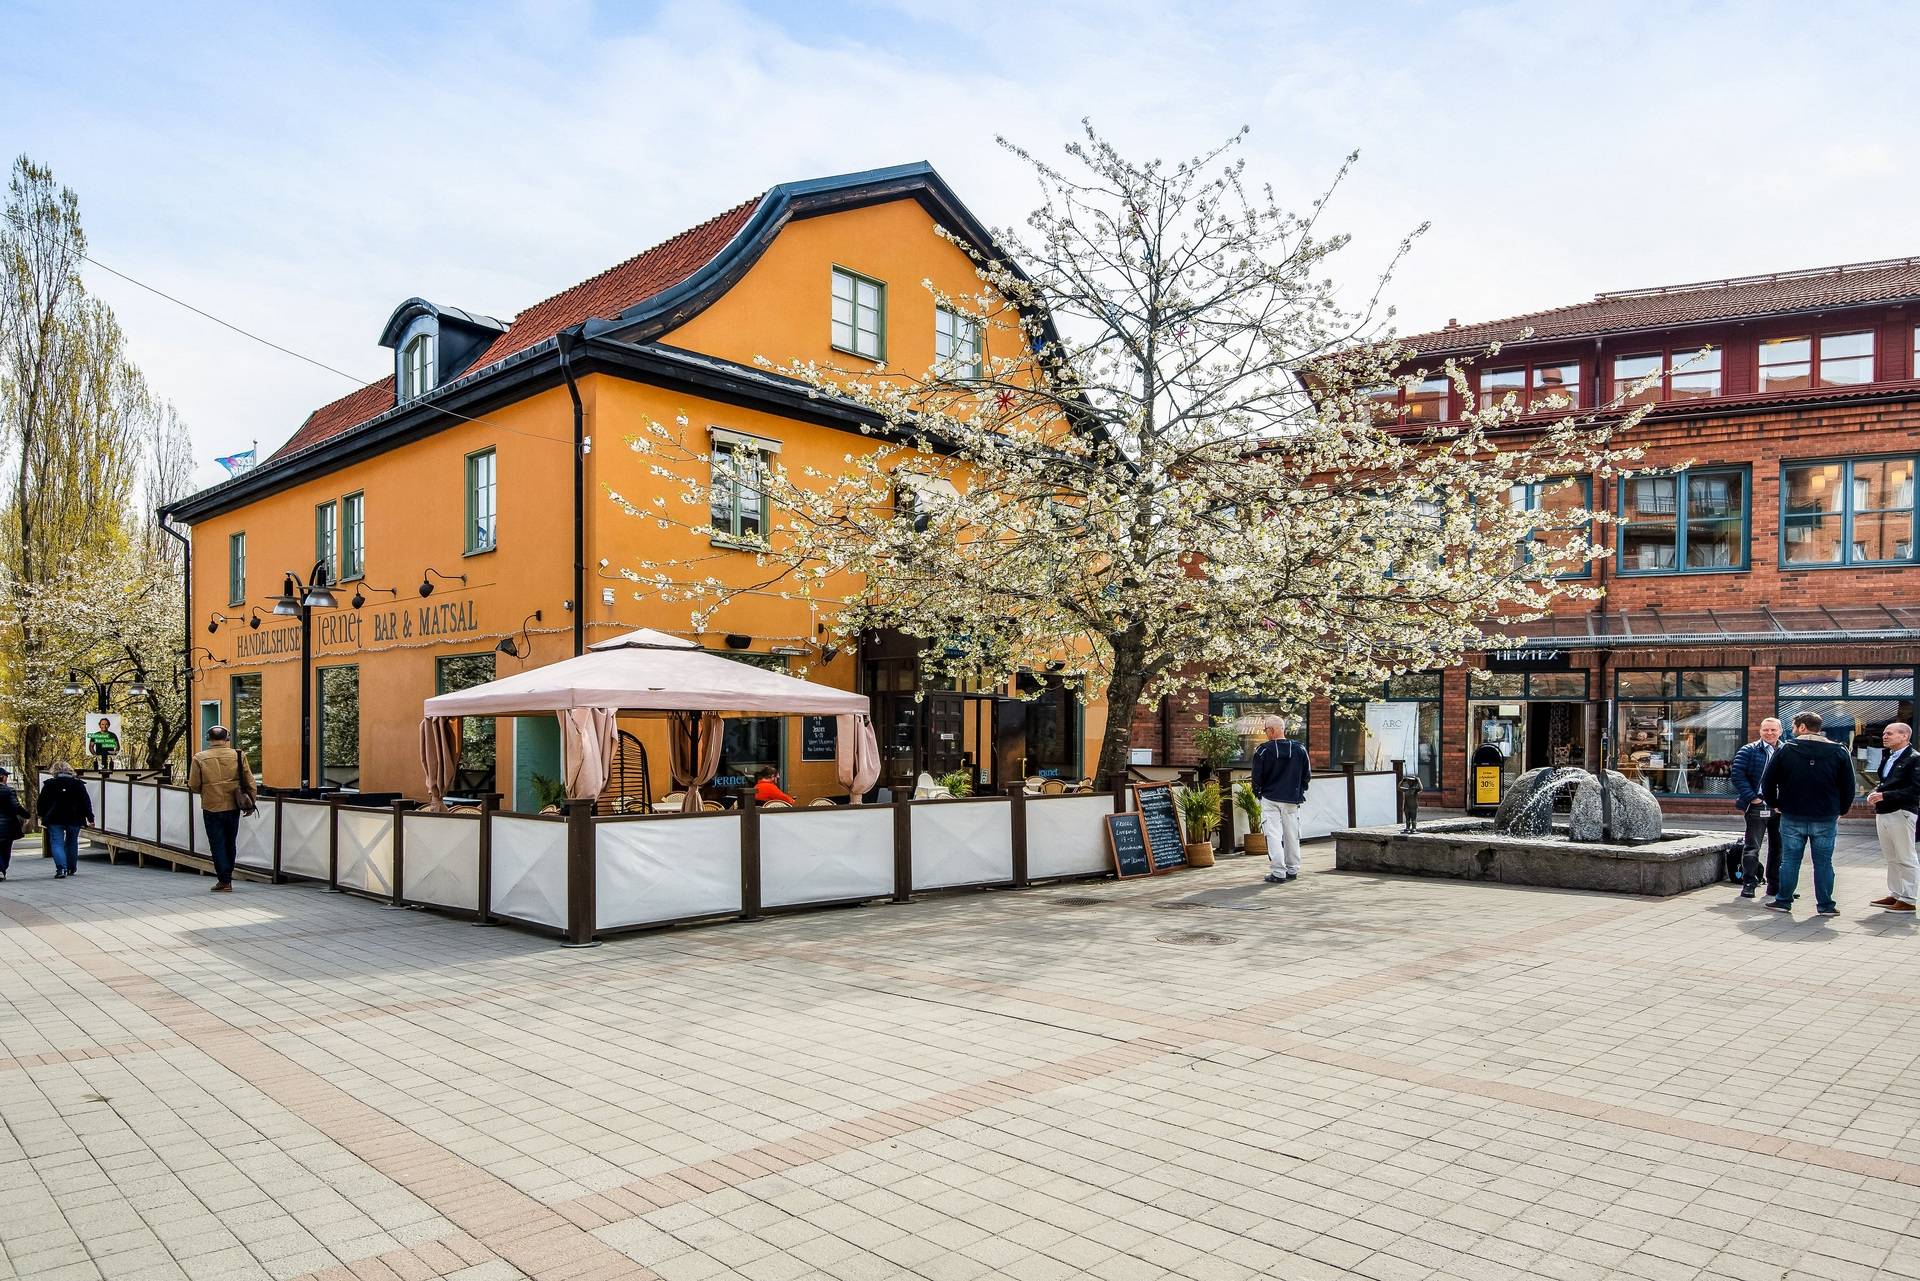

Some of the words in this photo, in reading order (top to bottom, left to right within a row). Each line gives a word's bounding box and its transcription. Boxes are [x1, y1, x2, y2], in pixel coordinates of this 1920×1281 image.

[374, 612, 398, 640] BAR
[402, 609, 412, 638] &
[419, 600, 478, 636] MATSAL
[1496, 650, 1559, 660] HEMTEX
[1382, 719, 1402, 728] ARC
[1480, 780, 1495, 788] 30%
